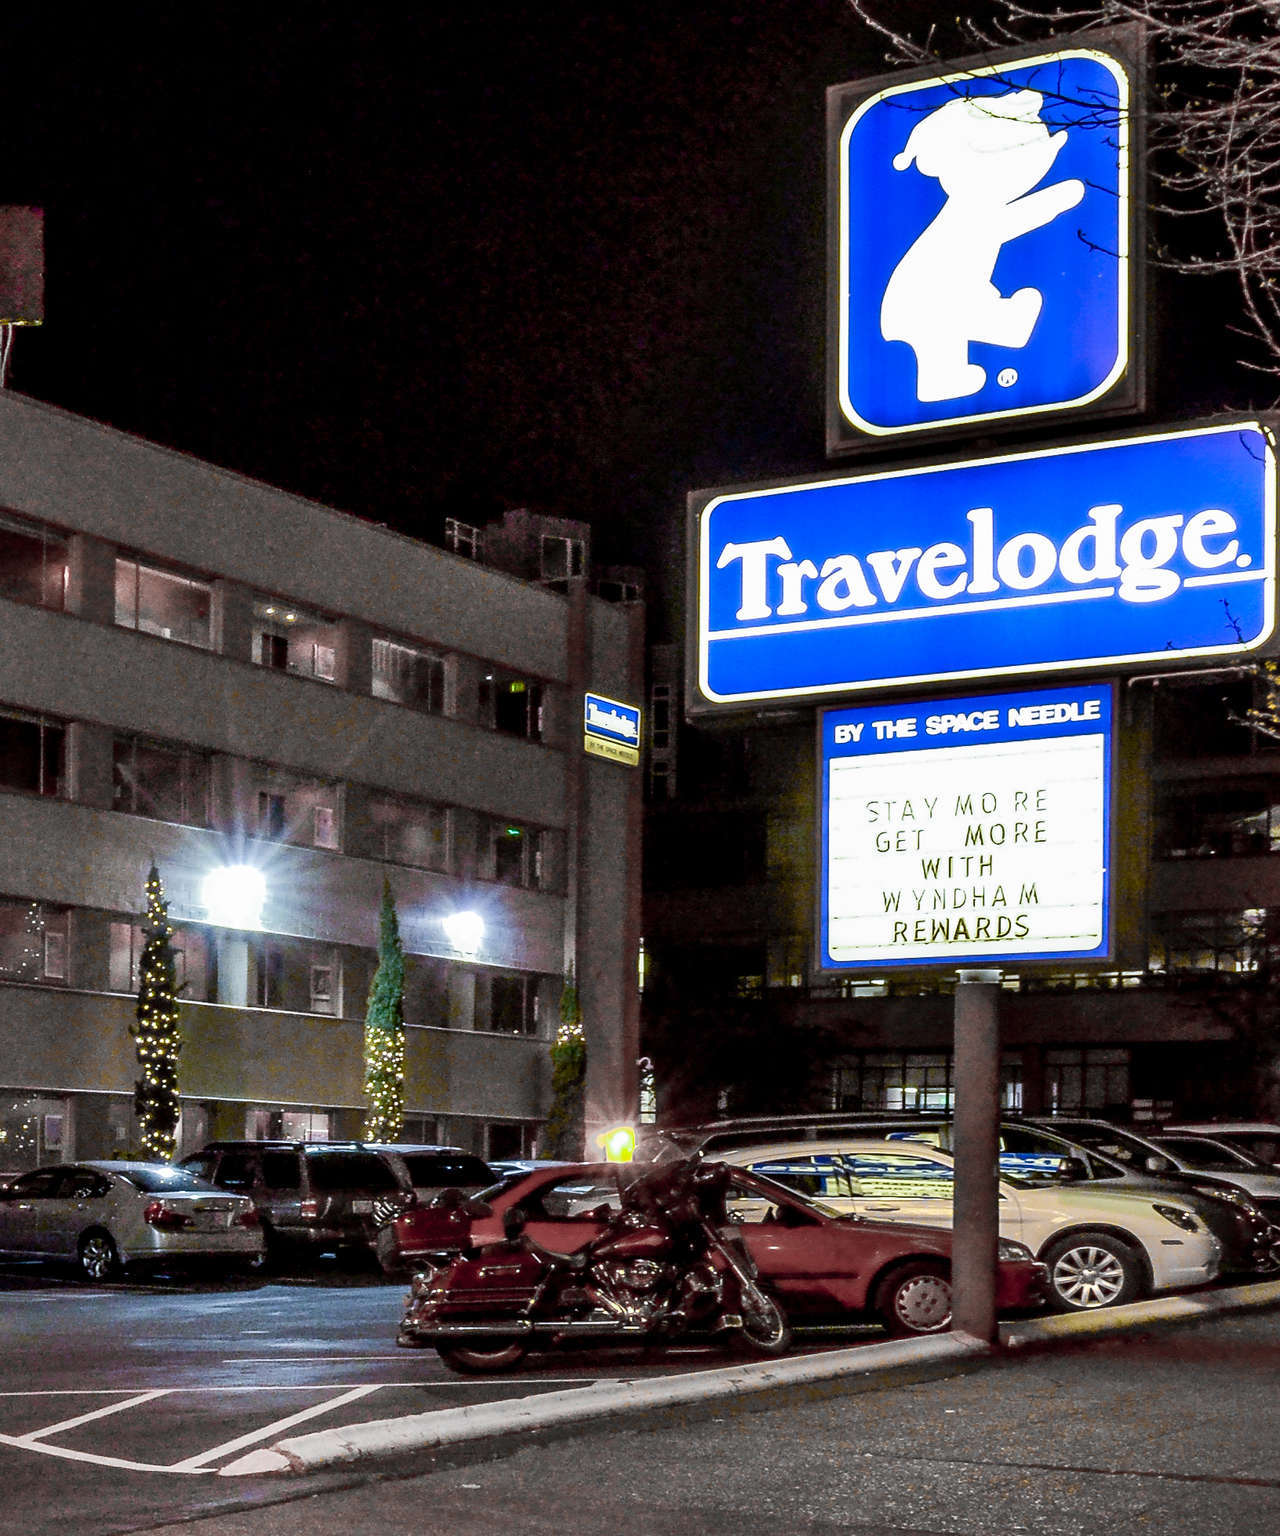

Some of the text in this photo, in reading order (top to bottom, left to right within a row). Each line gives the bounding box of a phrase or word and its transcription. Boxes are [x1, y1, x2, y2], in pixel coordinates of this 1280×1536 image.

[834, 700, 1101, 743] BY THE SPACE NEEDLE
[865, 789, 1048, 823] STAY MORE
[875, 820, 1048, 852] GET MORE
[921, 854, 993, 879] WITH
[882, 883, 1039, 912] WYNDHAM
[893, 914, 1030, 943] REWARDS
